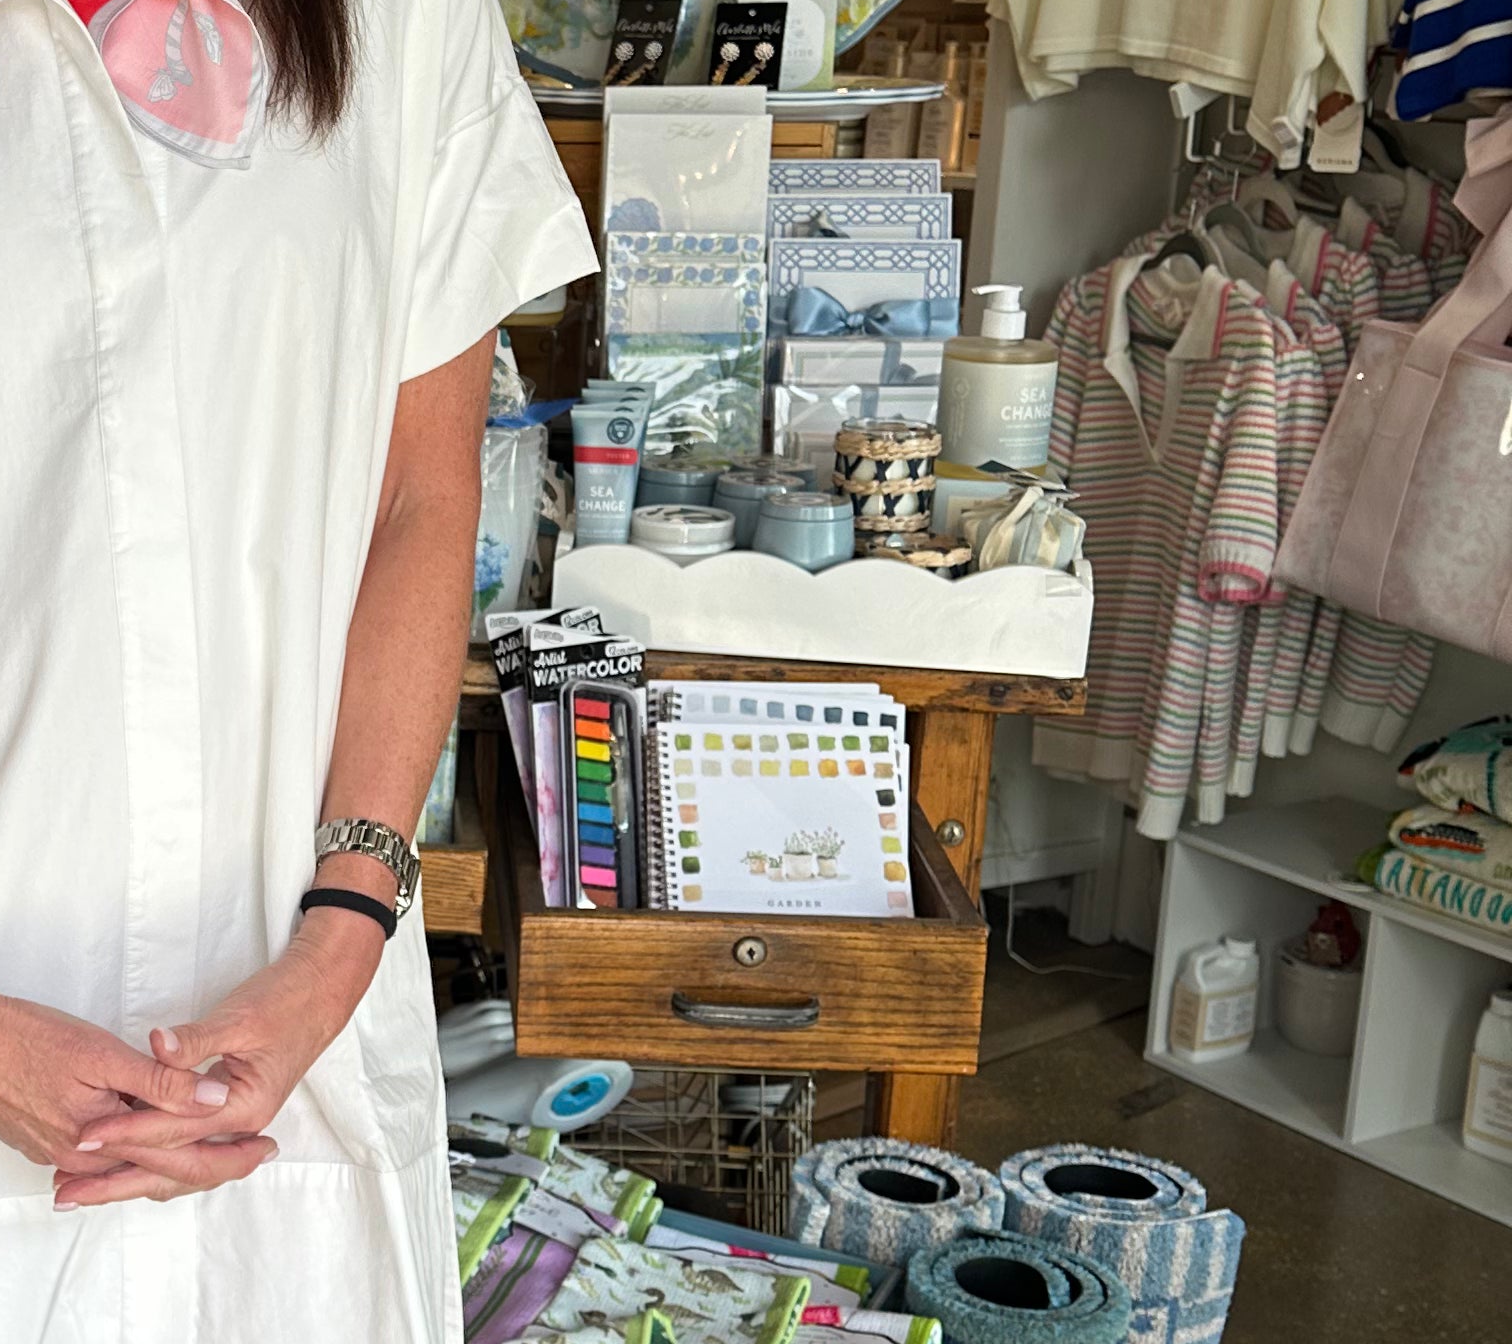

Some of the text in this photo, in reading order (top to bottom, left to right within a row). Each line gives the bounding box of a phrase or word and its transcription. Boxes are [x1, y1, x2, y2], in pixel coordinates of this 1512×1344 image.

[1019, 387, 1047, 404] SEA
[589, 485, 615, 498] SEA
[578, 499, 627, 513] CHANGE
[533, 655, 644, 687] WATERCOLOR
